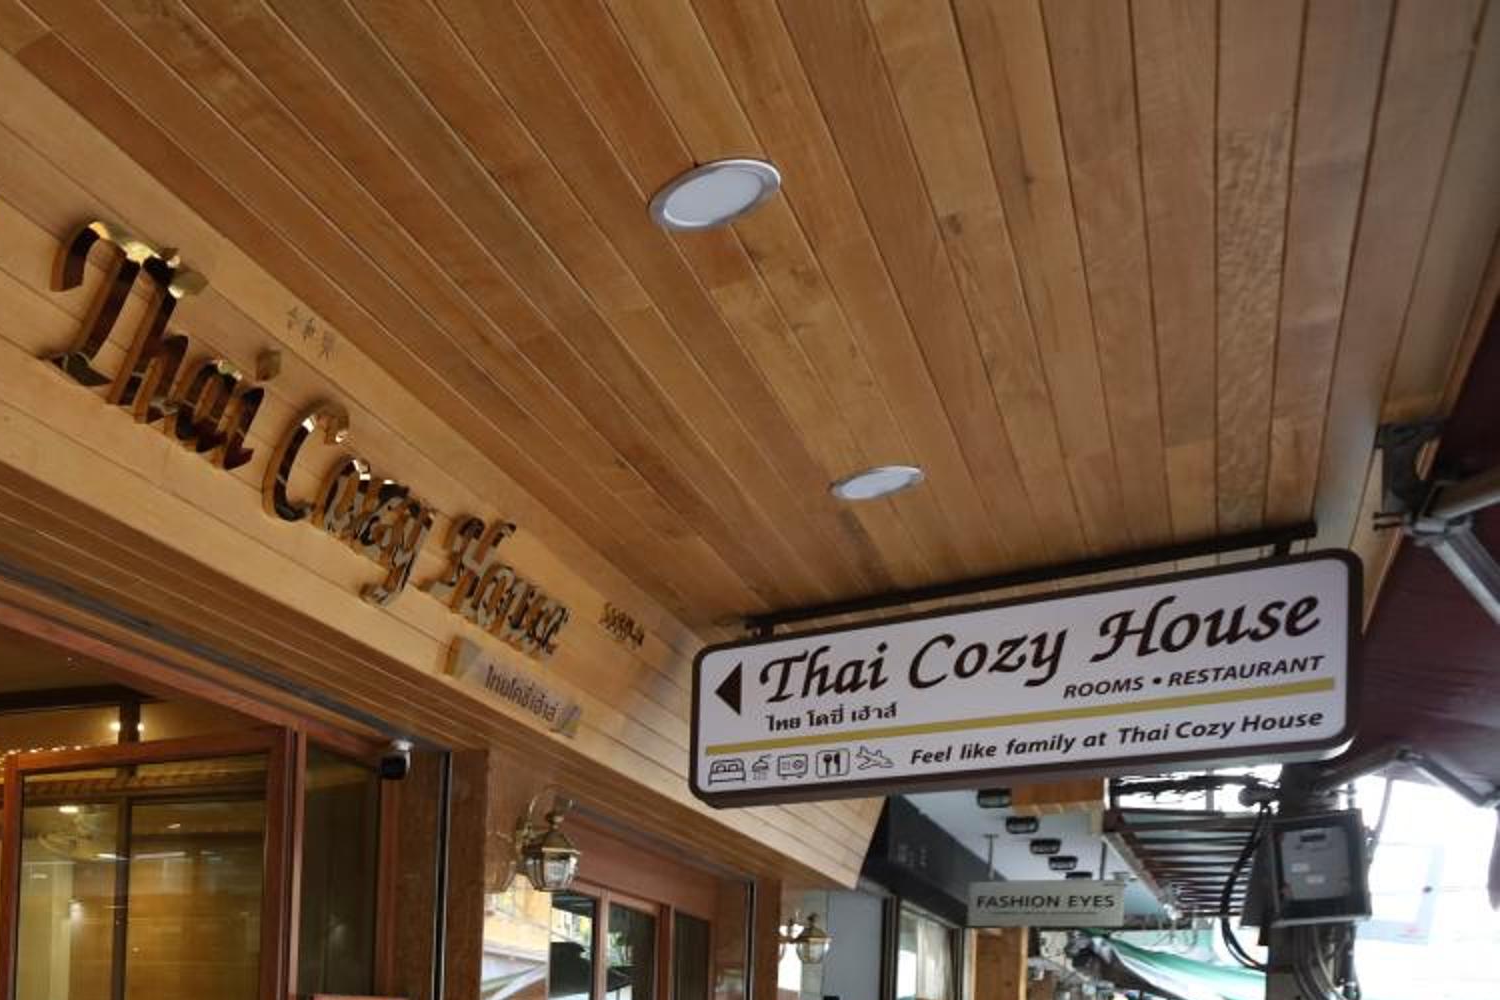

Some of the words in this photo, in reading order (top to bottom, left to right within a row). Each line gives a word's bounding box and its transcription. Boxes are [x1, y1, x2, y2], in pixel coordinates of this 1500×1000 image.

[42, 221, 282, 471] Thai
[262, 395, 437, 606] Cozy
[418, 512, 573, 657] House
[758, 641, 889, 704] Thai
[907, 628, 1068, 690] Cozy
[1089, 594, 1321, 664] House
[1062, 675, 1145, 700] ROOMS
[1166, 654, 1326, 688] RESTAURANT
[764, 714, 801, 732] ไทย
[910, 746, 953, 765] Feel
[959, 741, 997, 760] like
[1005, 733, 1076, 755] family
[1083, 731, 1107, 748] at
[1118, 722, 1171, 745] Thai
[1175, 718, 1235, 740] Cozy
[1241, 710, 1324, 733] House
[976, 895, 1060, 909] FASHION
[1067, 894, 1115, 908] EYES
